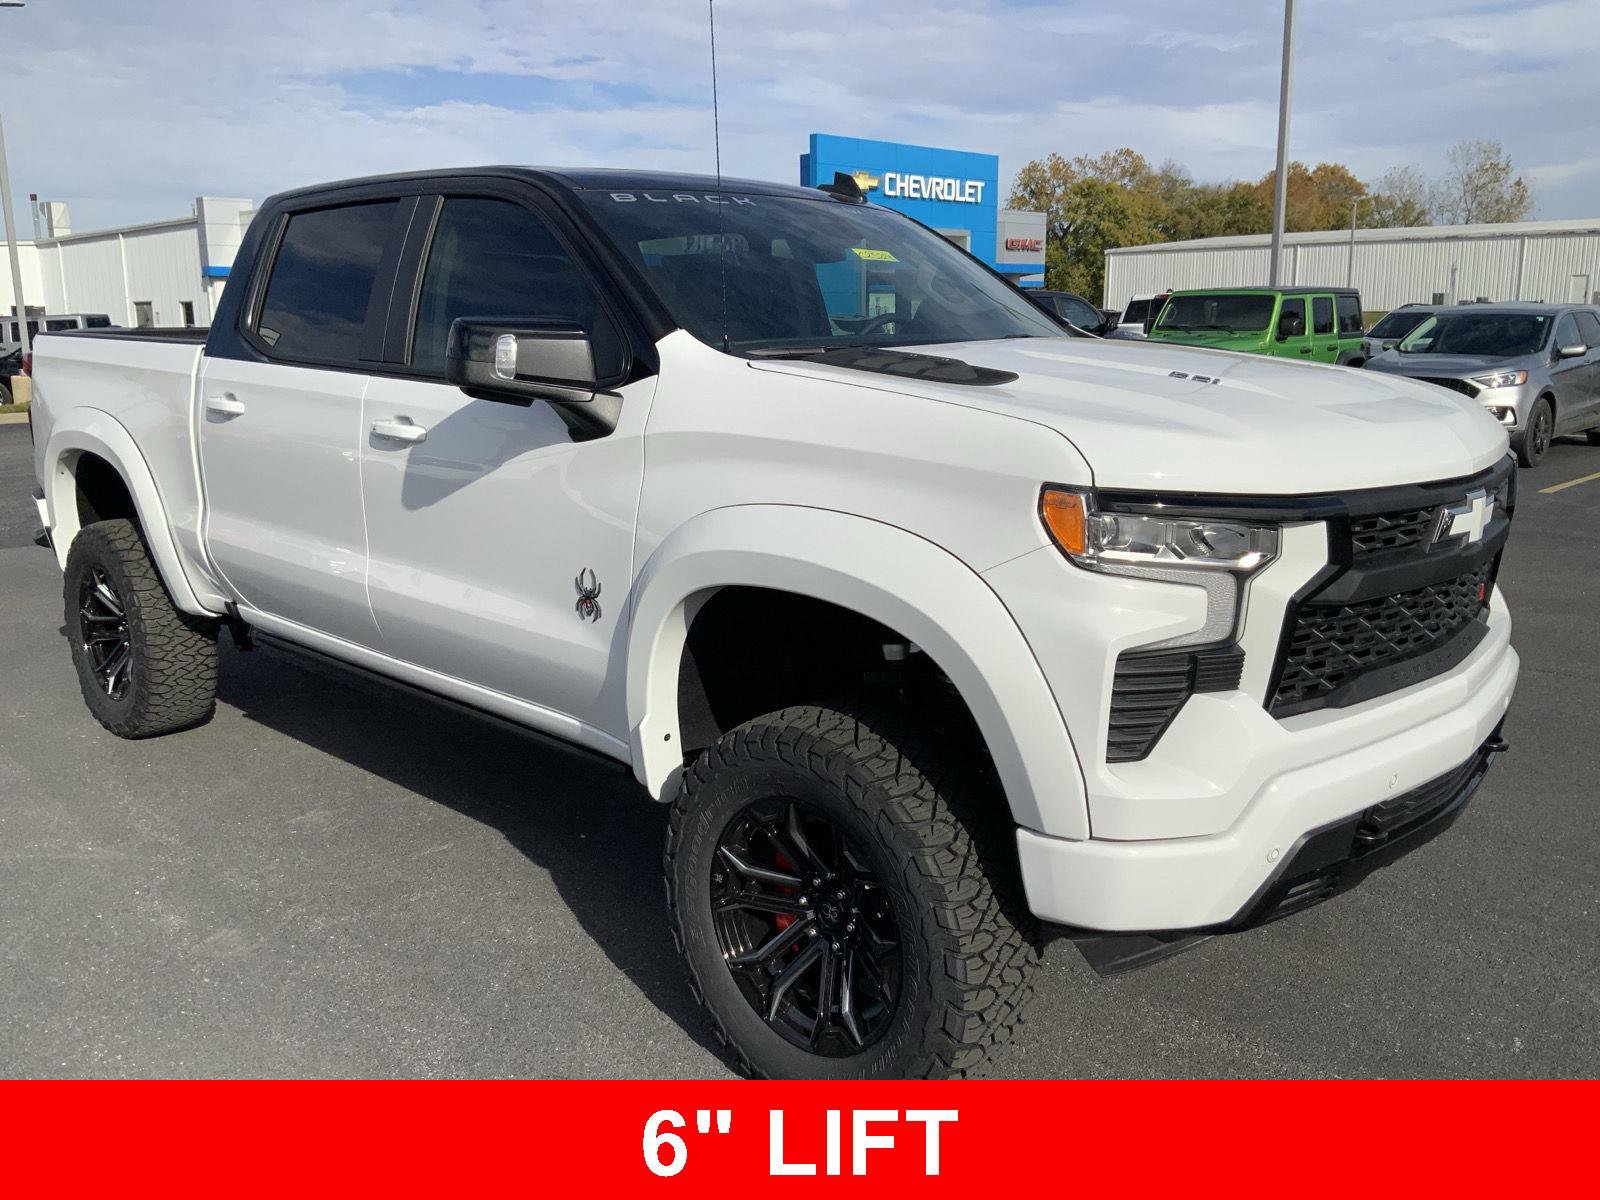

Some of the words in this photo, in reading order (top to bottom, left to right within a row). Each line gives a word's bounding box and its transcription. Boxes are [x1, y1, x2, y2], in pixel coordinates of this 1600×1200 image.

[884, 172, 985, 203] CHEVROLET
[609, 193, 757, 206] BLACK
[1006, 238, 1042, 251] GMC
